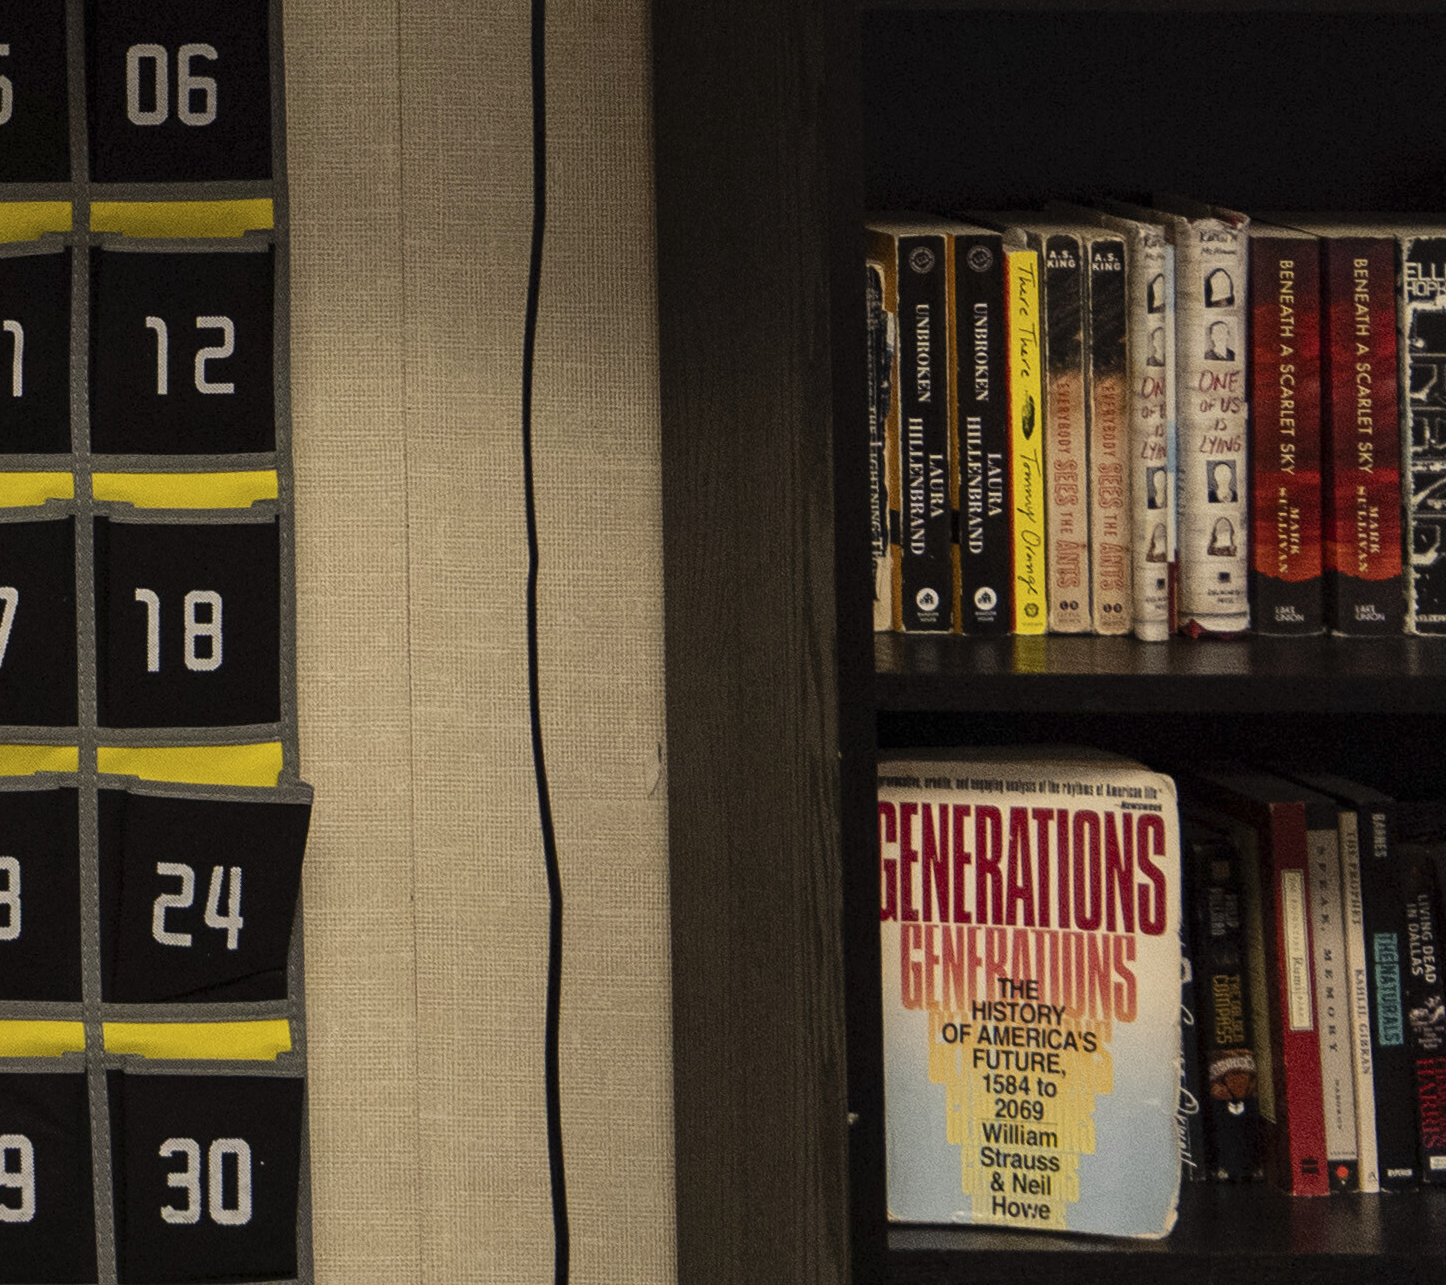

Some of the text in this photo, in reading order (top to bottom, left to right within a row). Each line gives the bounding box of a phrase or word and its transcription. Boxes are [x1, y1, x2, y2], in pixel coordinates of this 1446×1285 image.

[127, 44, 218, 126] 06
[916, 304, 932, 403] UNBROKEN
[1279, 259, 1296, 476] BENEATH A SCARLET SKY
[909, 417, 925, 556] HILLENBRAND
[929, 454, 945, 518] LAURA
[135, 587, 223, 673] 18
[878, 801, 1166, 936] GENERATIONS
[998, 978, 1039, 1001] THE
[972, 1001, 1065, 1026] HISTORY
[942, 1023, 1097, 1052] OF AMERICA'S
[973, 1049, 1066, 1079] FUTURE,
[982, 1074, 1057, 1097] 1584 to
[995, 1098, 1044, 1120] 2069
[982, 1122, 1058, 1148] William
[980, 1147, 1060, 1172] Strauss
[991, 1172, 1051, 1195] & Neil
[992, 1195, 1050, 1219] Howe
